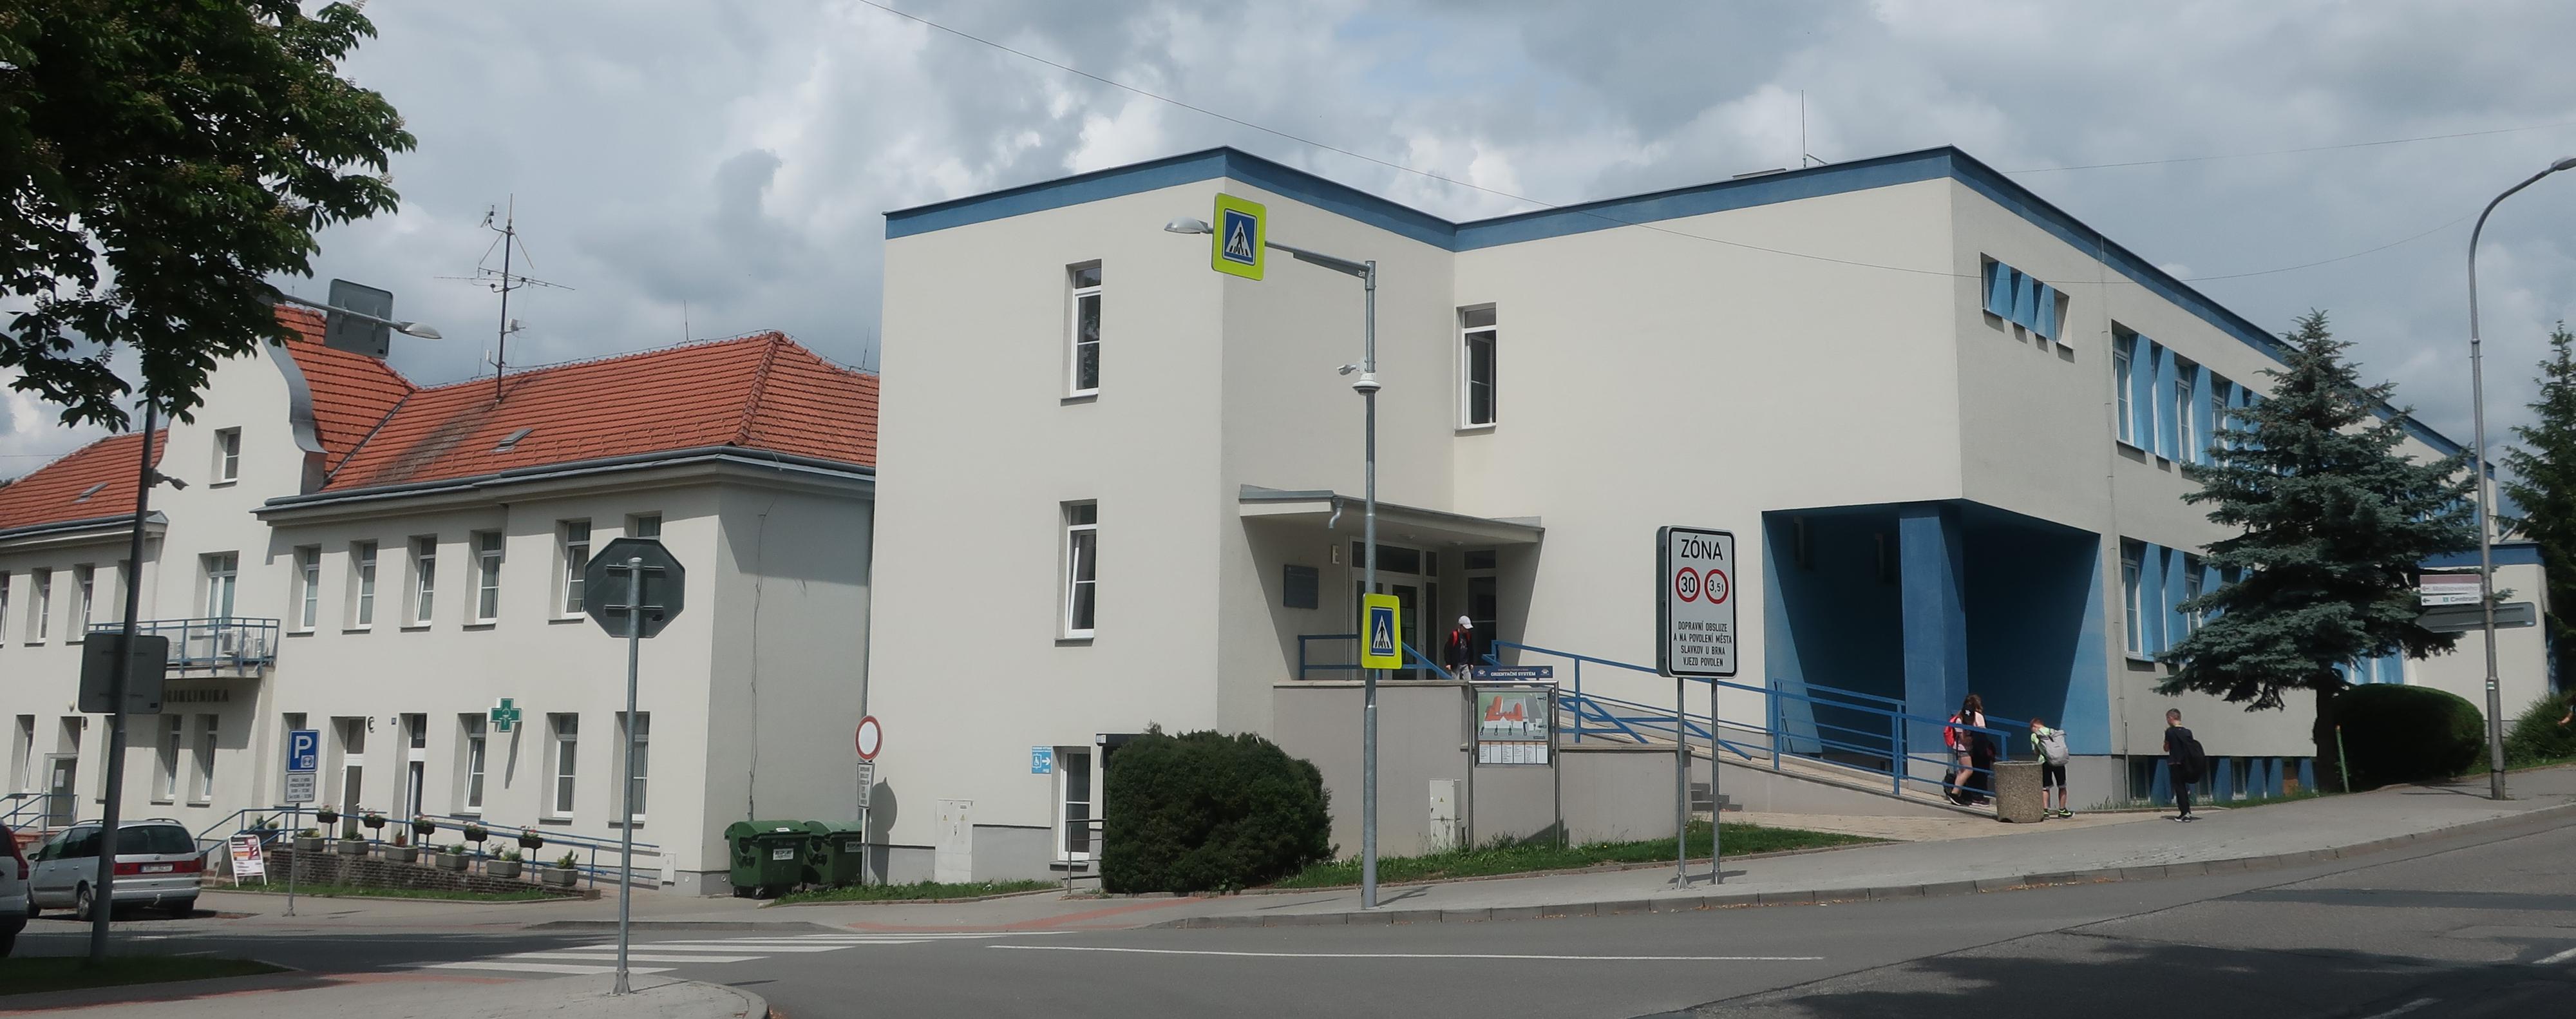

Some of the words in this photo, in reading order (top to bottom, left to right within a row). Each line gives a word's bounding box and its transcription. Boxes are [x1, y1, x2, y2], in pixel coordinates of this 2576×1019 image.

[1681, 535, 1723, 560] ZÓNA
[1681, 576, 1695, 593] 30
[1678, 621, 1703, 631] DOPRAVNÍ
[1706, 623, 1727, 632] OBSLUZE
[1689, 633, 1714, 643] POVOLENÍ
[1716, 634, 1732, 643] MĚSTA
[1681, 645, 1703, 654] SLAVKOV
[1706, 646, 1709, 654] U
[1683, 657, 1698, 666] VJEZD
[1701, 658, 1723, 667] POVOLEN
[294, 735, 312, 759] P
